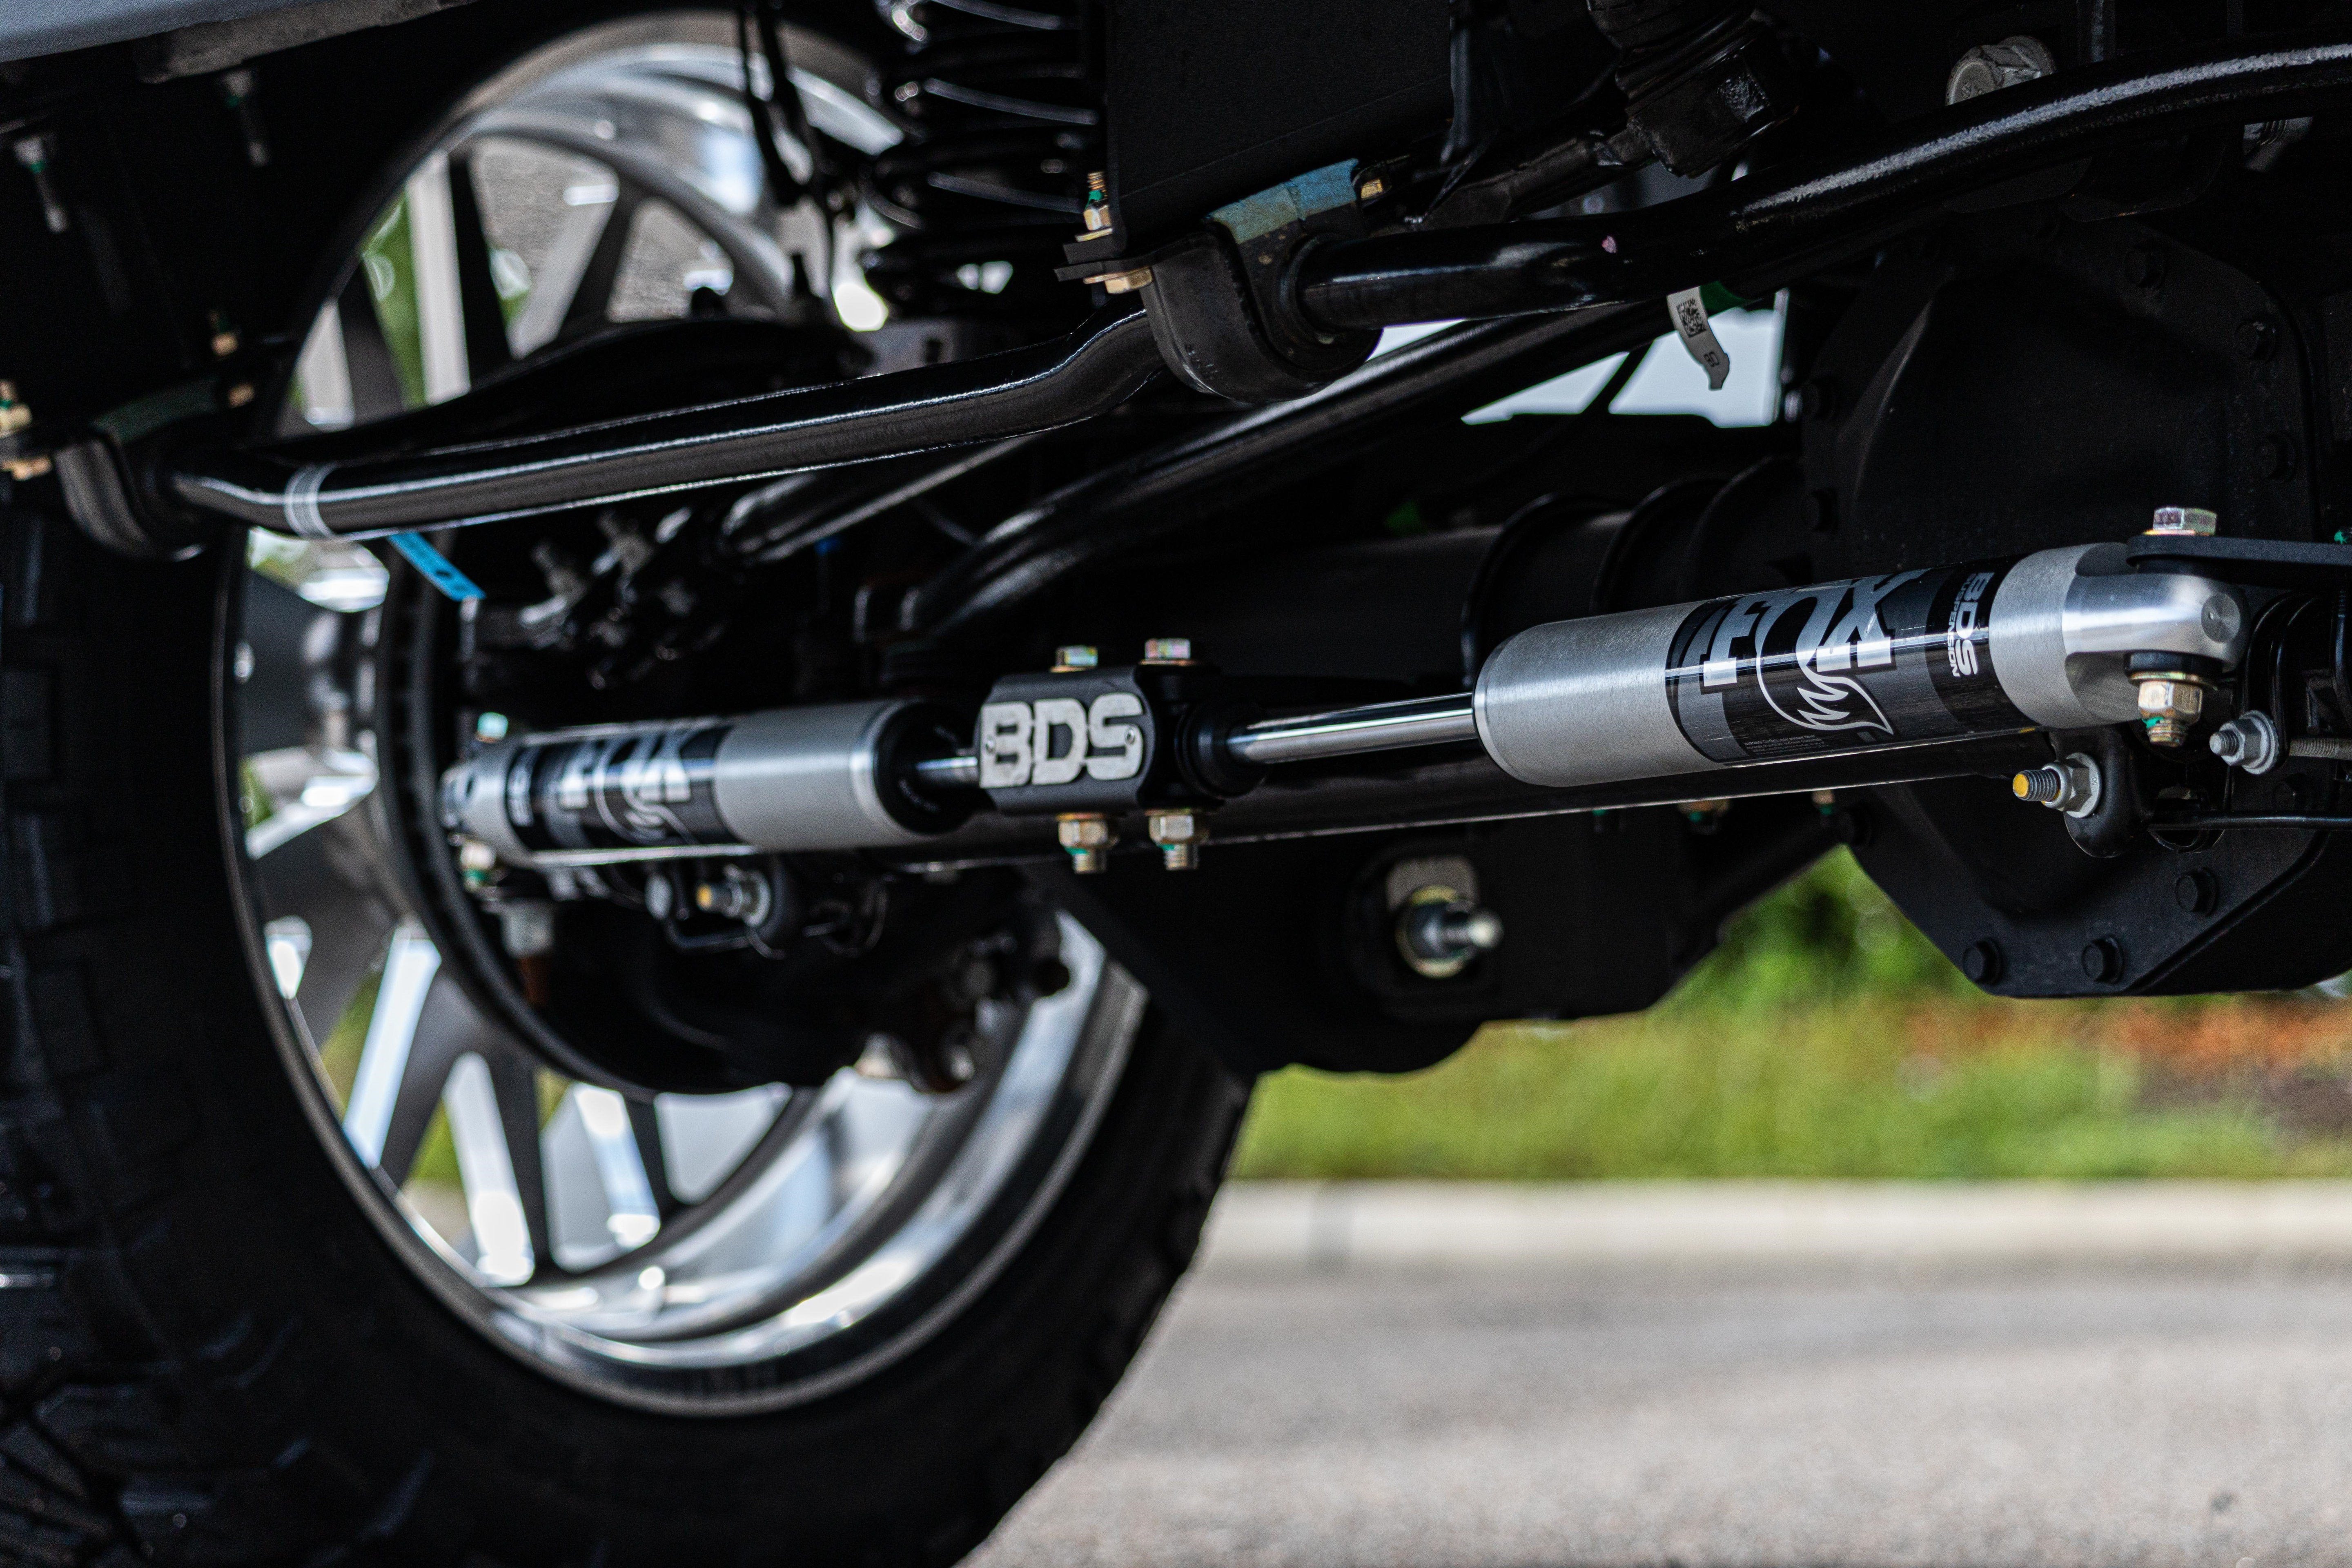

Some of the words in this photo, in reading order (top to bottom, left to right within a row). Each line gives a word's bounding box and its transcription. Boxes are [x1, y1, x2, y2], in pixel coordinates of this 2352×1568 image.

[1704, 567, 1933, 735] FOX
[1947, 573, 1977, 677] SUSPENSION
[1955, 572, 1995, 675] BDS
[980, 693, 1143, 788] BDS
